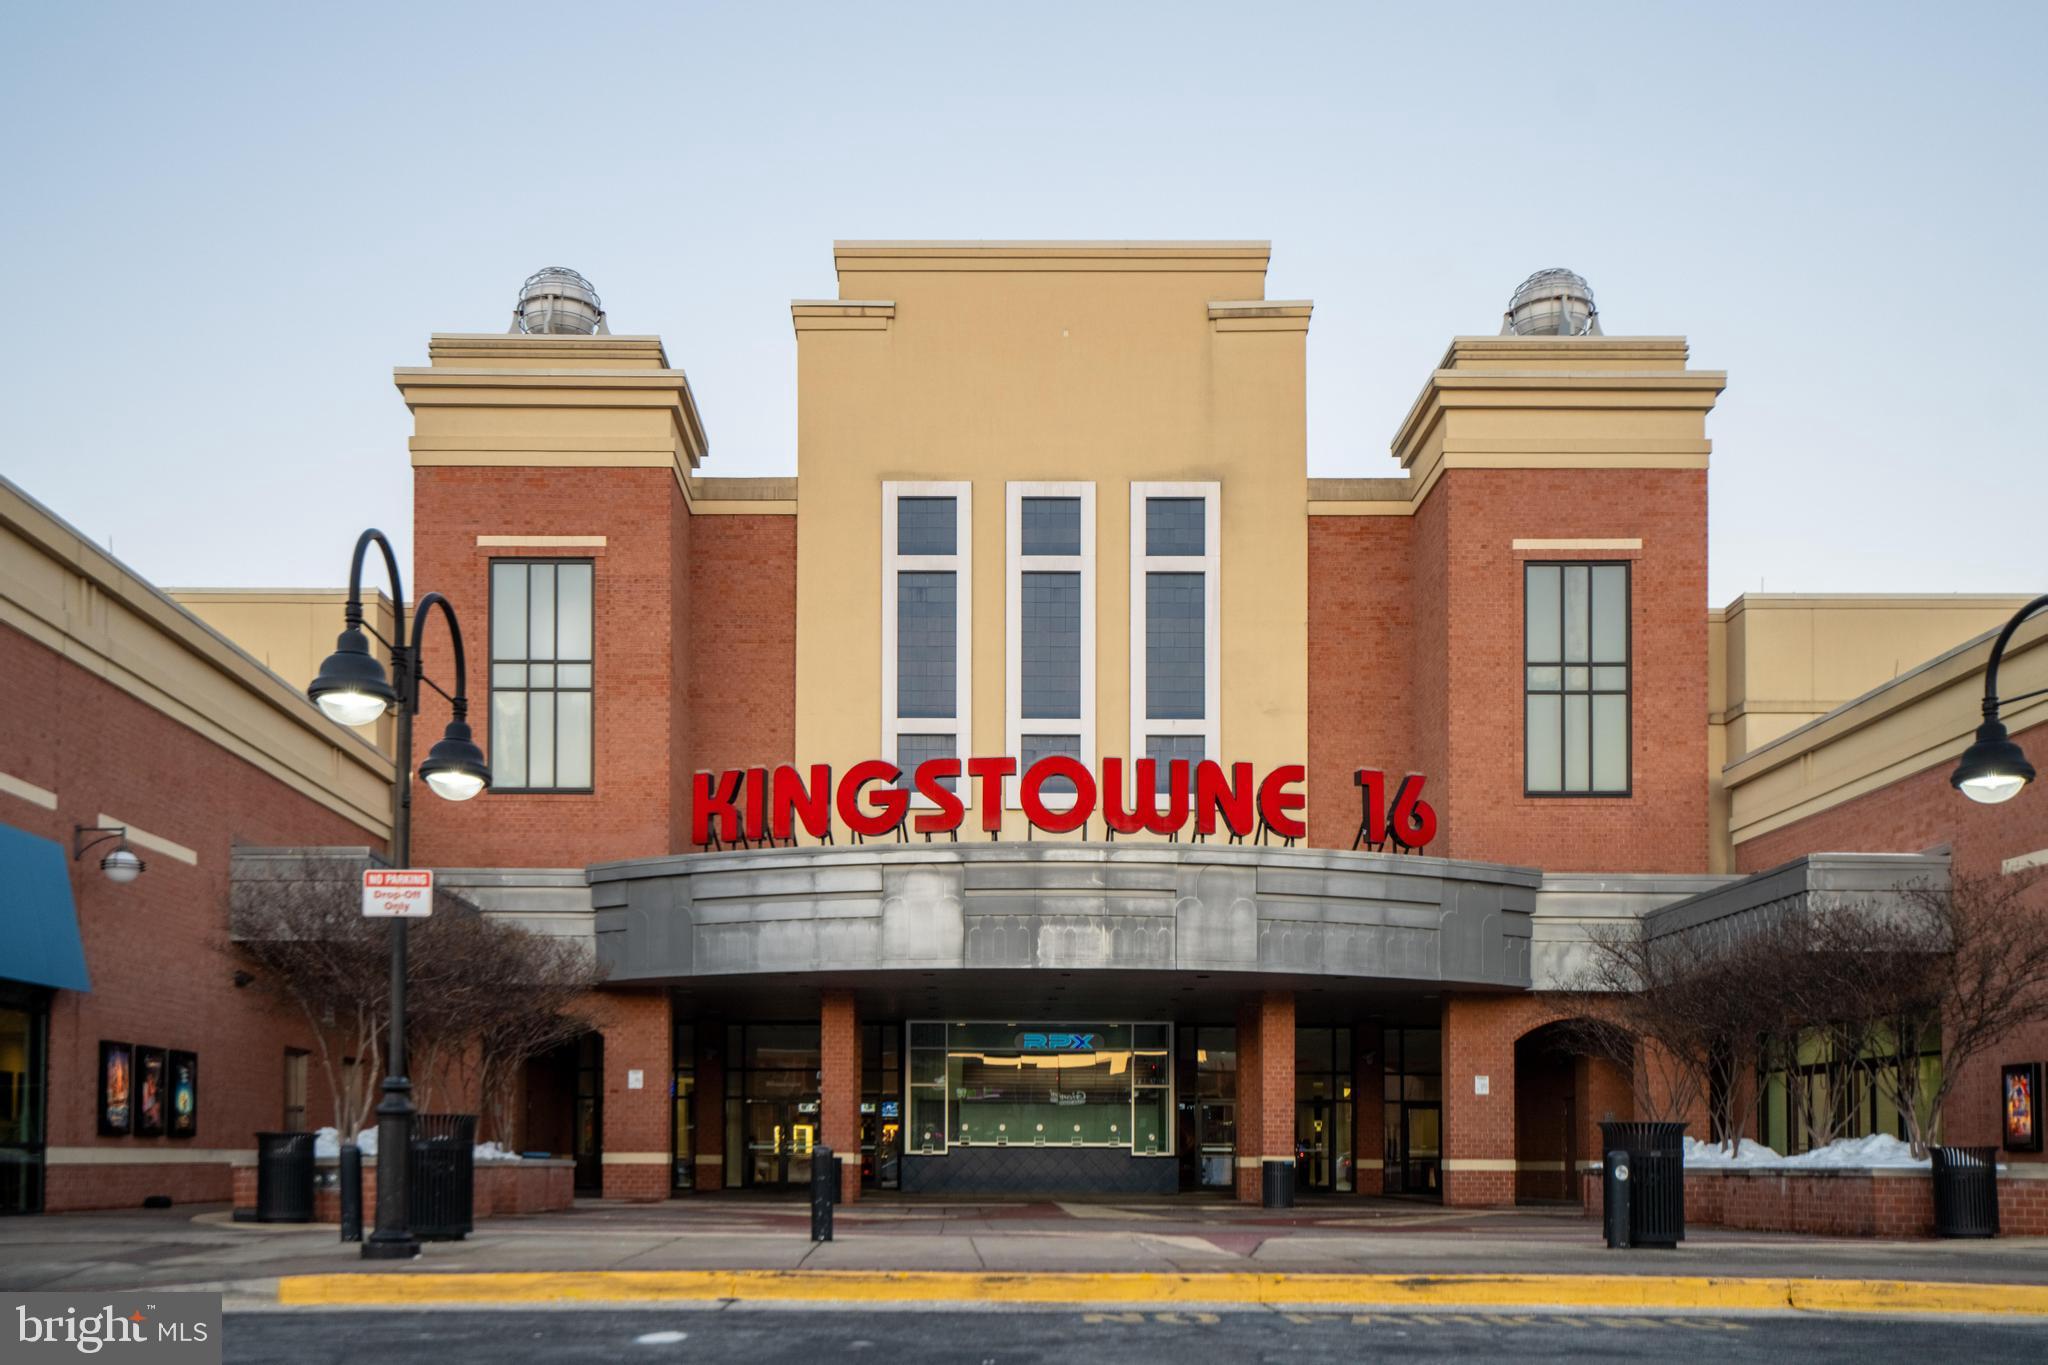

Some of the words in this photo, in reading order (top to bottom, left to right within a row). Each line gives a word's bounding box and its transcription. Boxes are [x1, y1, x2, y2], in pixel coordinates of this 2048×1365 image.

[692, 755, 1306, 846] KINGSTOWNE
[1356, 769, 1437, 848] 16
[368, 874, 383, 884] NO
[385, 874, 427, 884] PARKING
[373, 890, 421, 900] Drop-Off
[384, 902, 410, 912] Only
[1023, 1033, 1094, 1049] RPX
